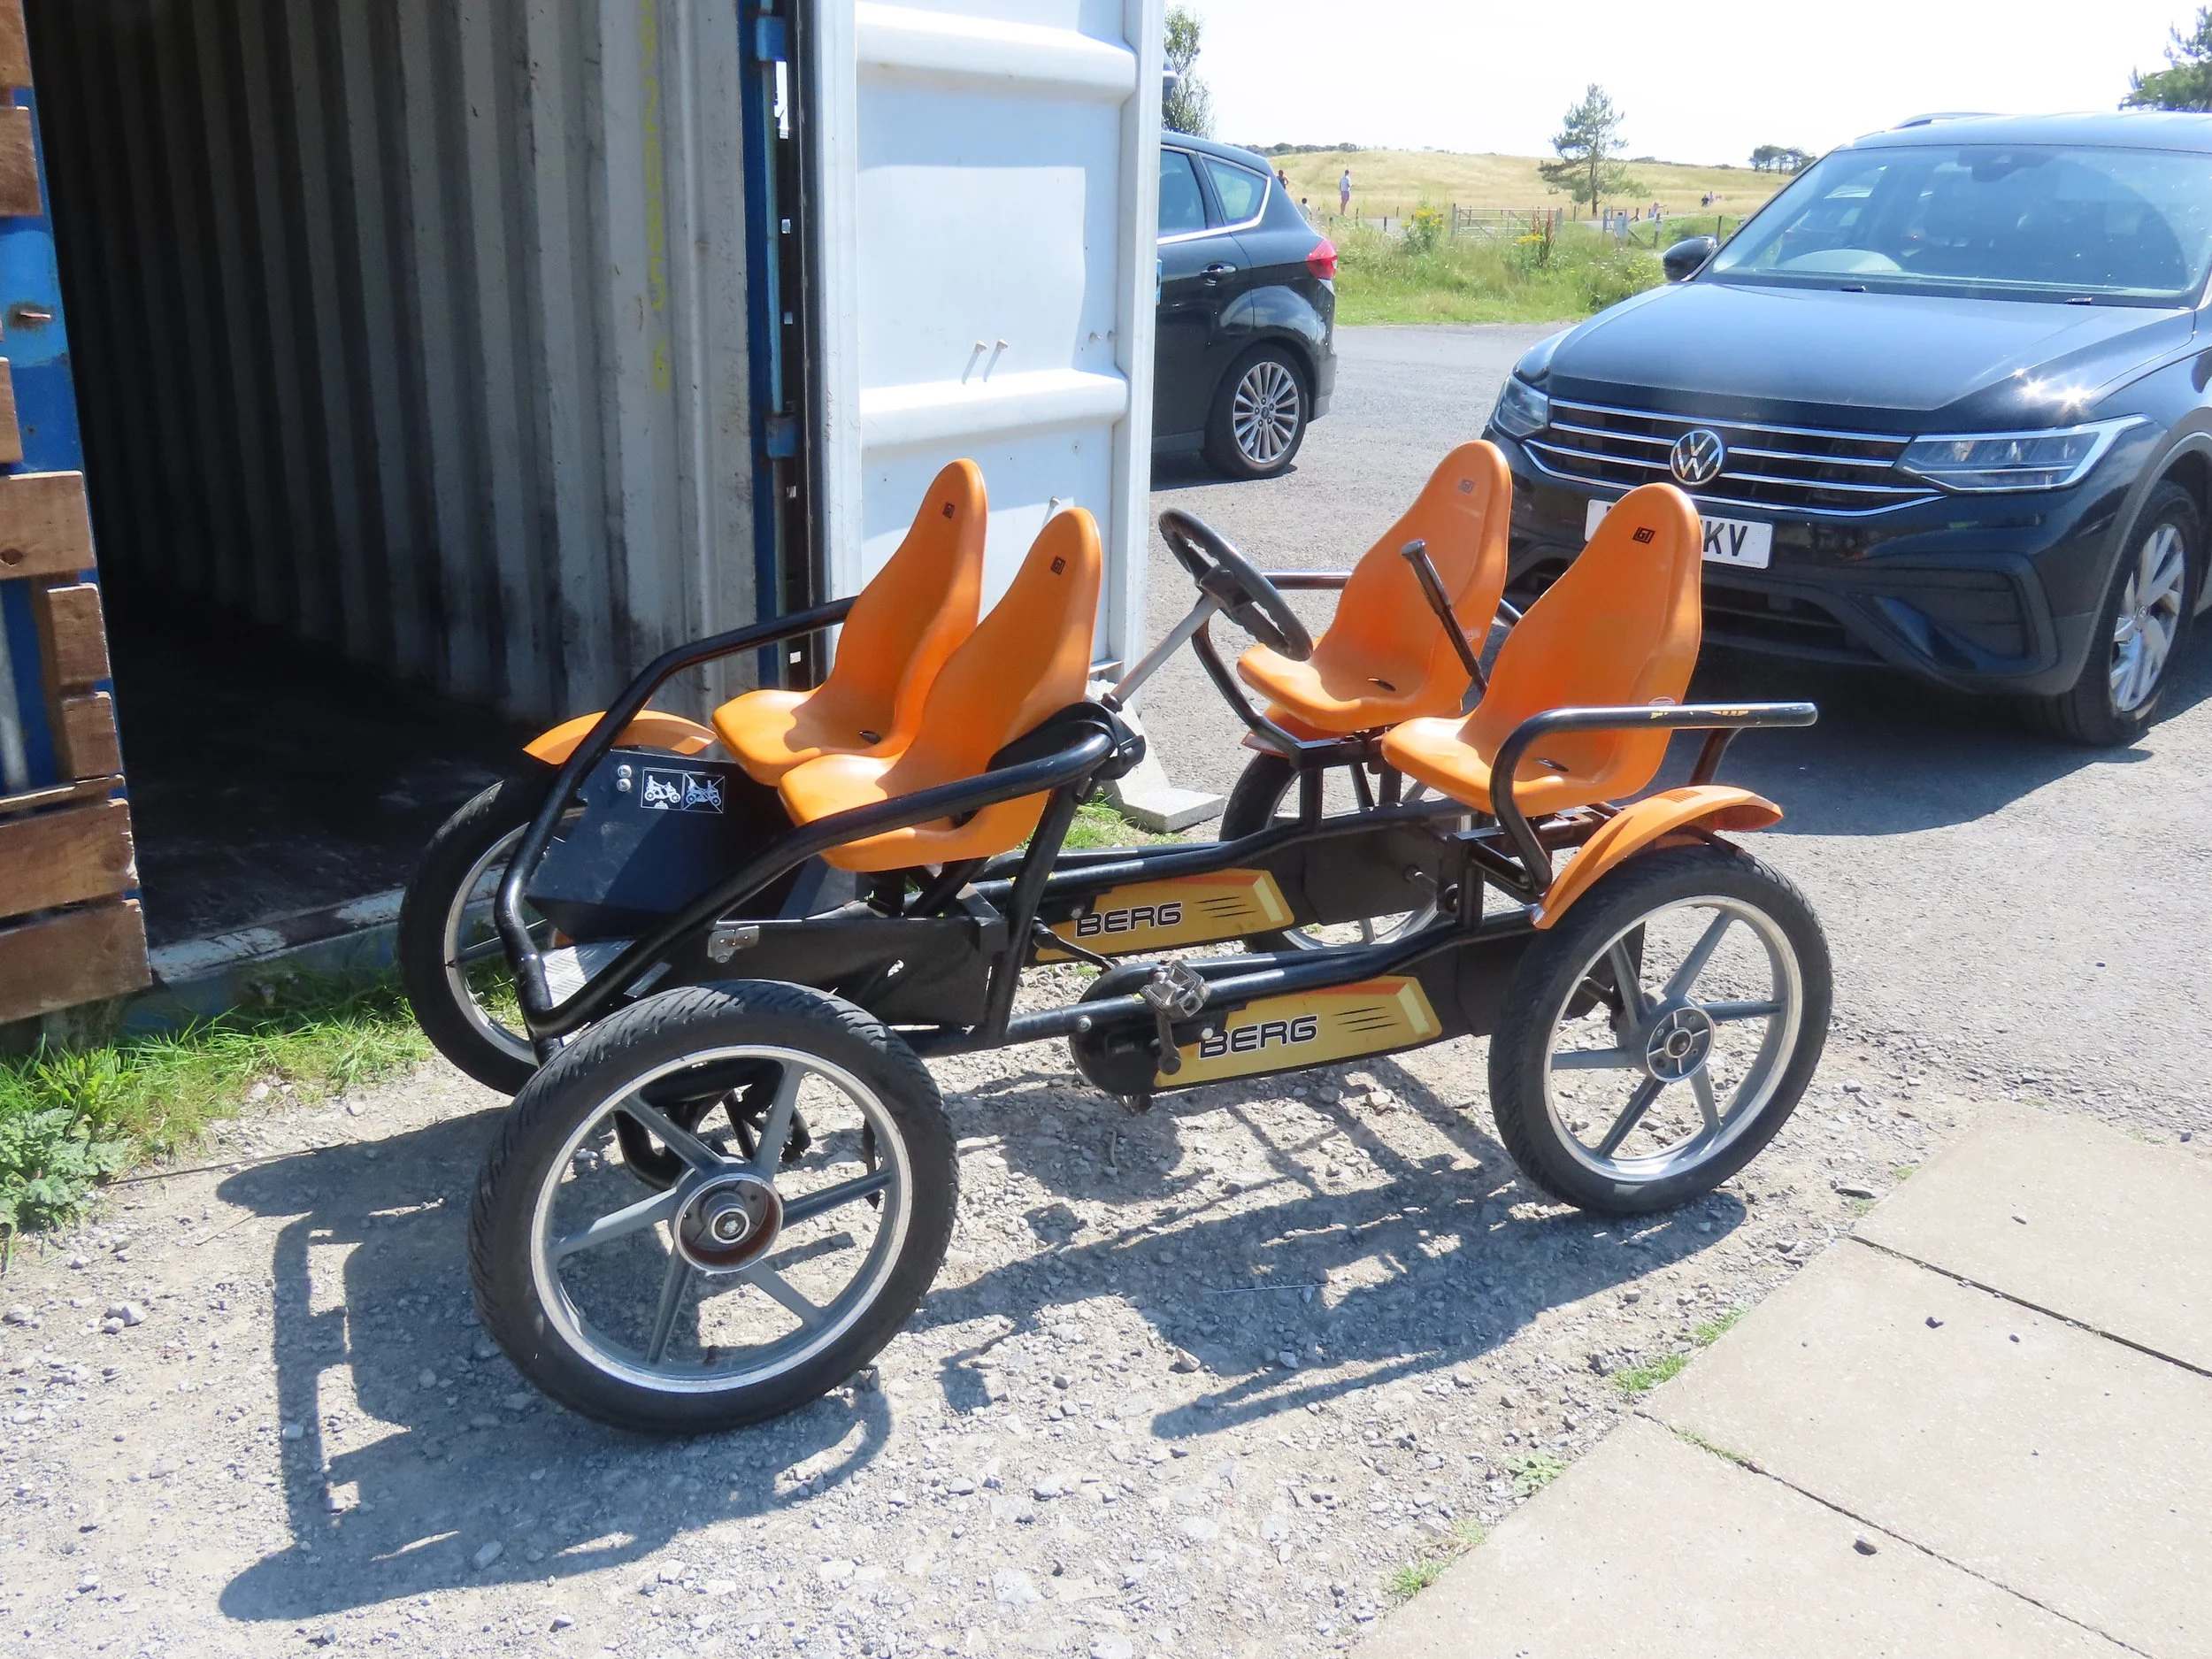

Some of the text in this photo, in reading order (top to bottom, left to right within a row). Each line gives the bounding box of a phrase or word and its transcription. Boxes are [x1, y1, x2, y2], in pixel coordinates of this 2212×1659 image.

[1700, 520, 1748, 557] KV
[1075, 902, 1182, 938] BERG
[1199, 1014, 1318, 1060] BERG
